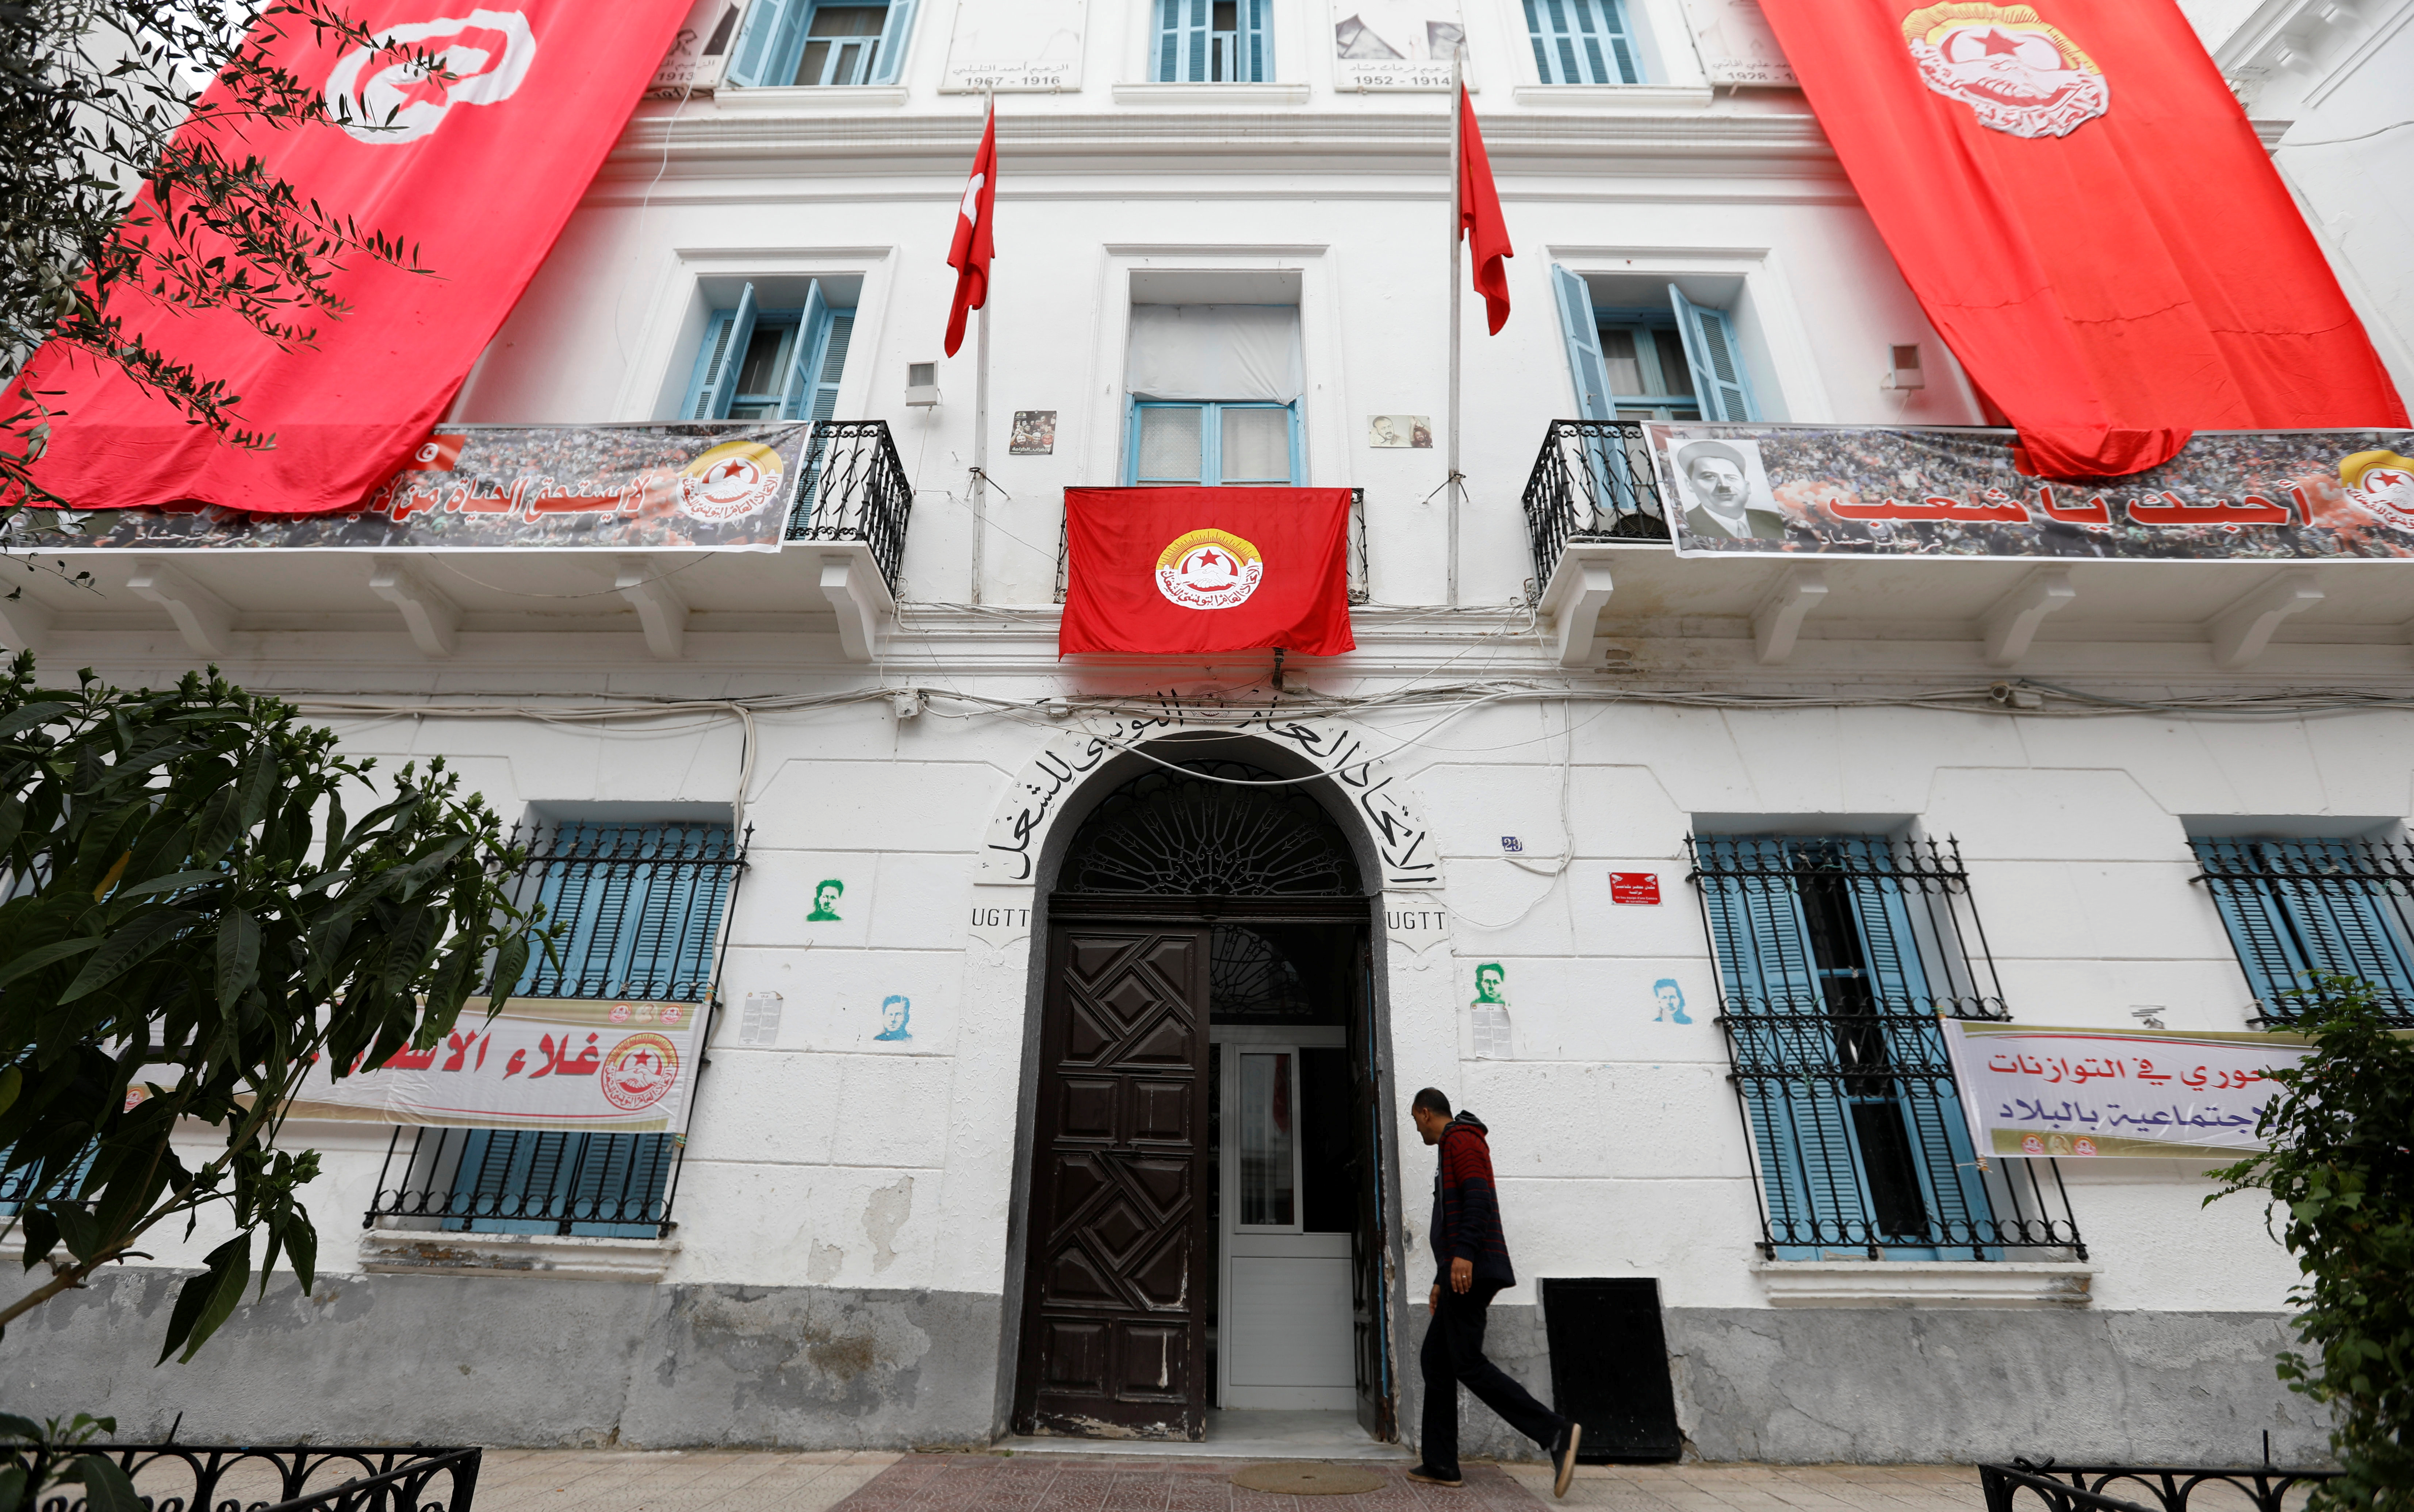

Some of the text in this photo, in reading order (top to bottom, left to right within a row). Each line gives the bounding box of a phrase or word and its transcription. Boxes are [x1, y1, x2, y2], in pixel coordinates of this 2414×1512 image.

[999, 61, 1027, 72] أحمد
[1030, 64, 1069, 74] الزعيم
[1380, 64, 1417, 73] فرحات
[1421, 64, 1453, 74] زعيم
[1022, 76, 1061, 85] 1916
[1354, 76, 1394, 85] 1952
[1411, 76, 1451, 85] 1914
[391, 484, 442, 523] من
[444, 475, 529, 524] الحياة
[522, 476, 624, 524] يستحق
[624, 475, 653, 511] لا
[1828, 487, 2032, 530] شعب
[2039, 484, 2112, 533] يا
[135, 526, 184, 540] حشاد
[1820, 529, 1943, 552] فرحات حشاد
[1504, 838, 1521, 851] 29
[972, 908, 1030, 927] UGTT
[1387, 912, 1446, 930] UGTT
[502, 1032, 601, 1080] غلاء
[1989, 1054, 2126, 1084] التوازنات
[2132, 1057, 2173, 1086] في
[2000, 1098, 2099, 1131] بالبلاد
